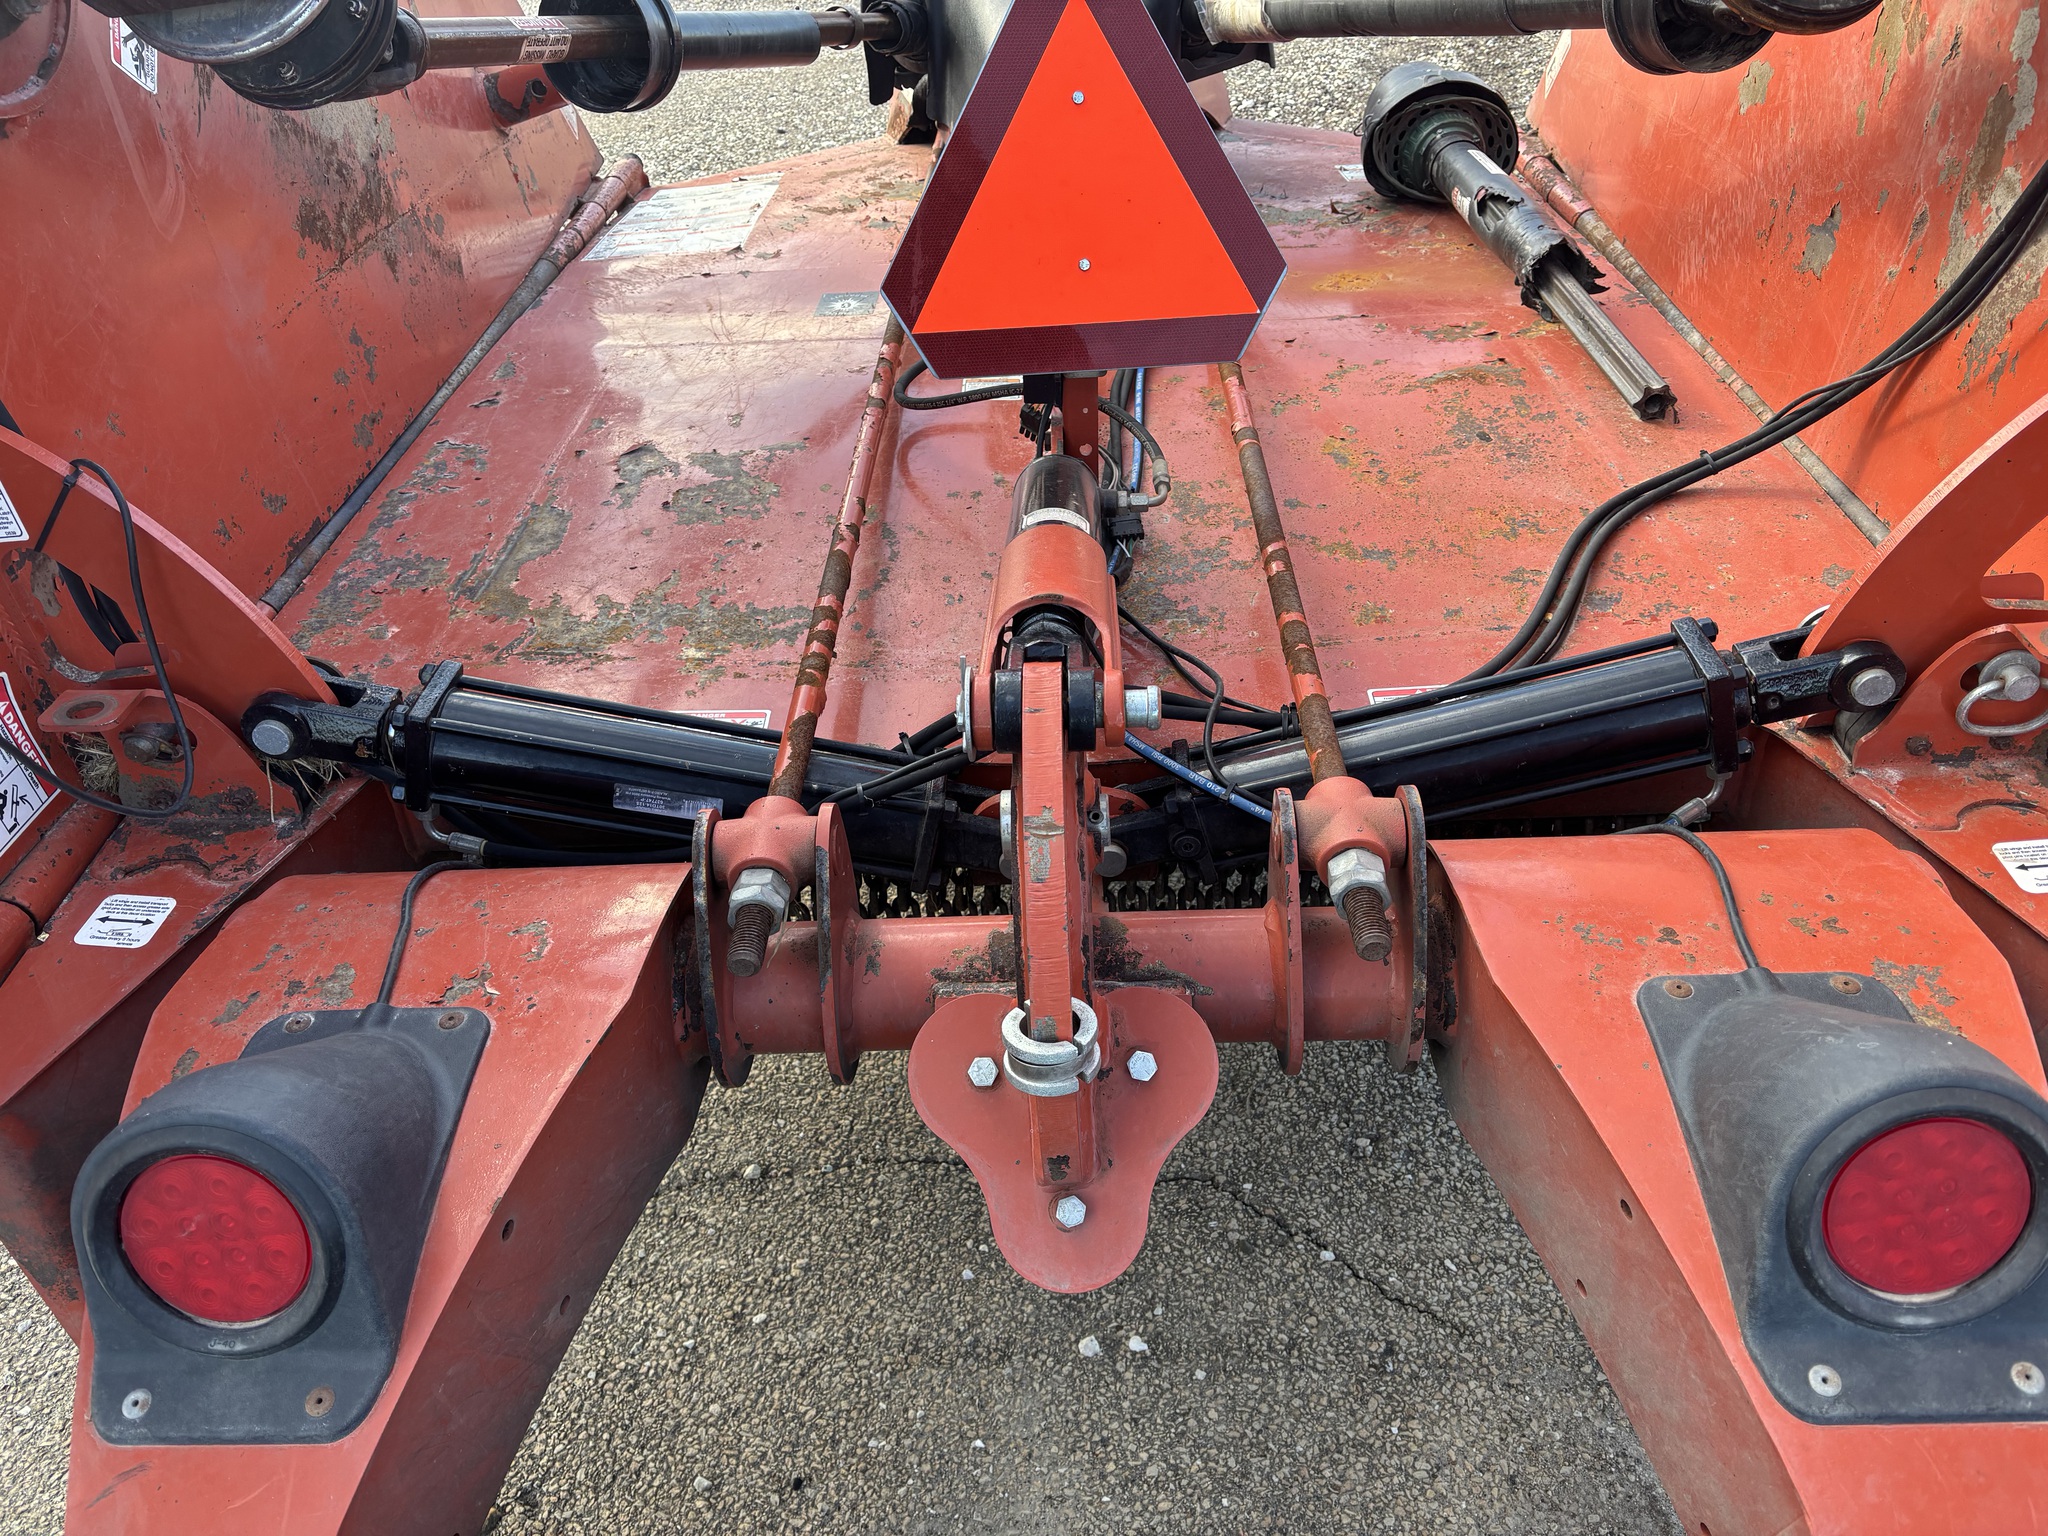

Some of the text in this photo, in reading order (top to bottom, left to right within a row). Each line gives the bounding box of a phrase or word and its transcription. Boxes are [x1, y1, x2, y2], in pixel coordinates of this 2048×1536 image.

[522, 50, 546, 61] MISSING
[3, 711, 42, 767] DANGE
[1128, 736, 1146, 750] MSHA
[1151, 750, 1181, 771] PSI 3000
[28, 769, 40, 790] Death
[1188, 772, 1221, 793] BAR 210
[1250, 805, 1266, 816] 1/4"
[210, 1338, 236, 1349] J-40
